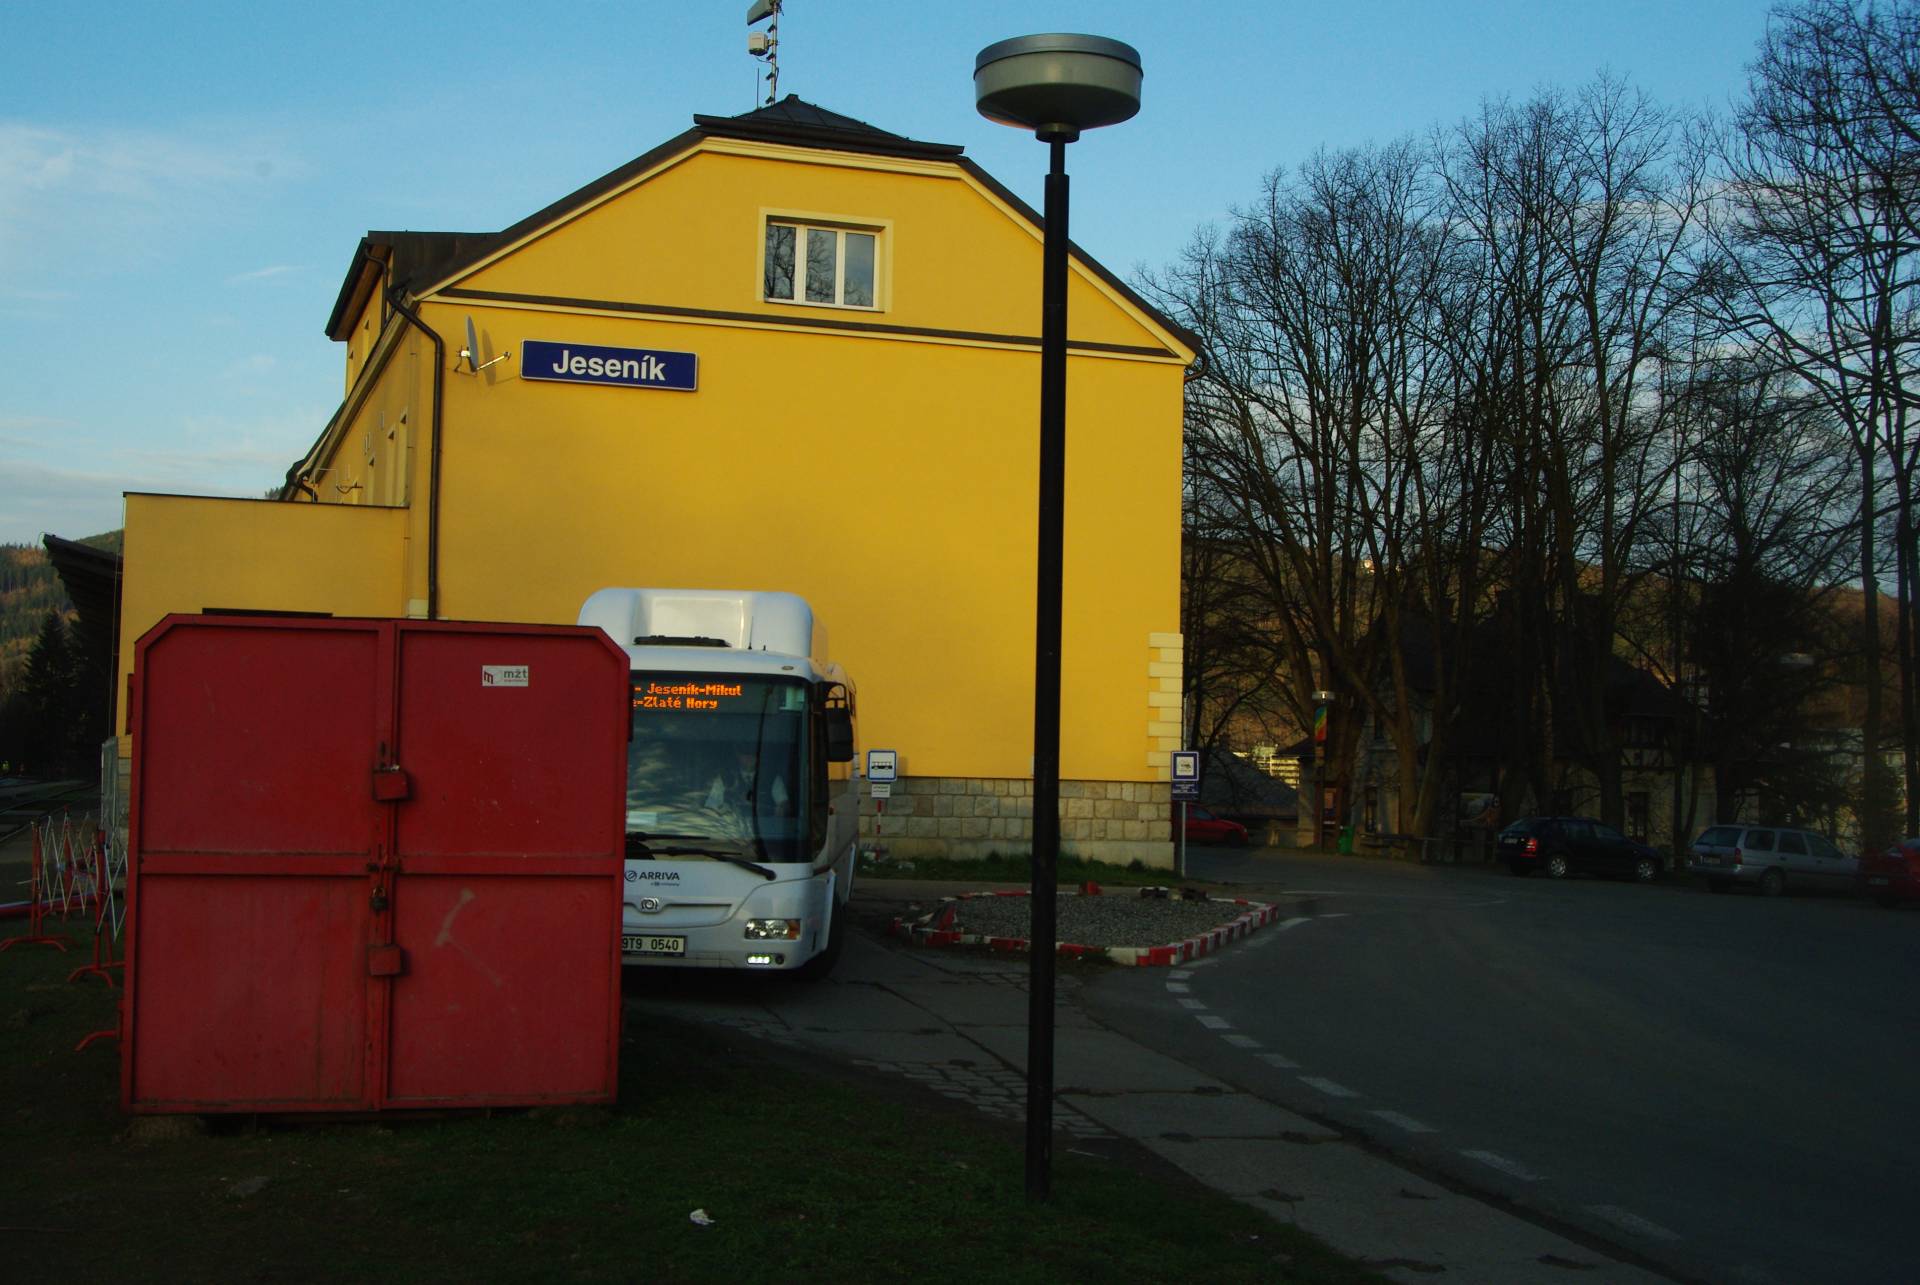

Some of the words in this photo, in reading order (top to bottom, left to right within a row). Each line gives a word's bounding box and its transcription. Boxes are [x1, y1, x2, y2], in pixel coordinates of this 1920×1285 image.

[552, 349, 666, 381] Jeseník
[686, 697, 718, 710] Hory
[639, 871, 680, 881] ARRIVA
[622, 938, 643, 949] 9T9
[650, 938, 679, 951] 0540
